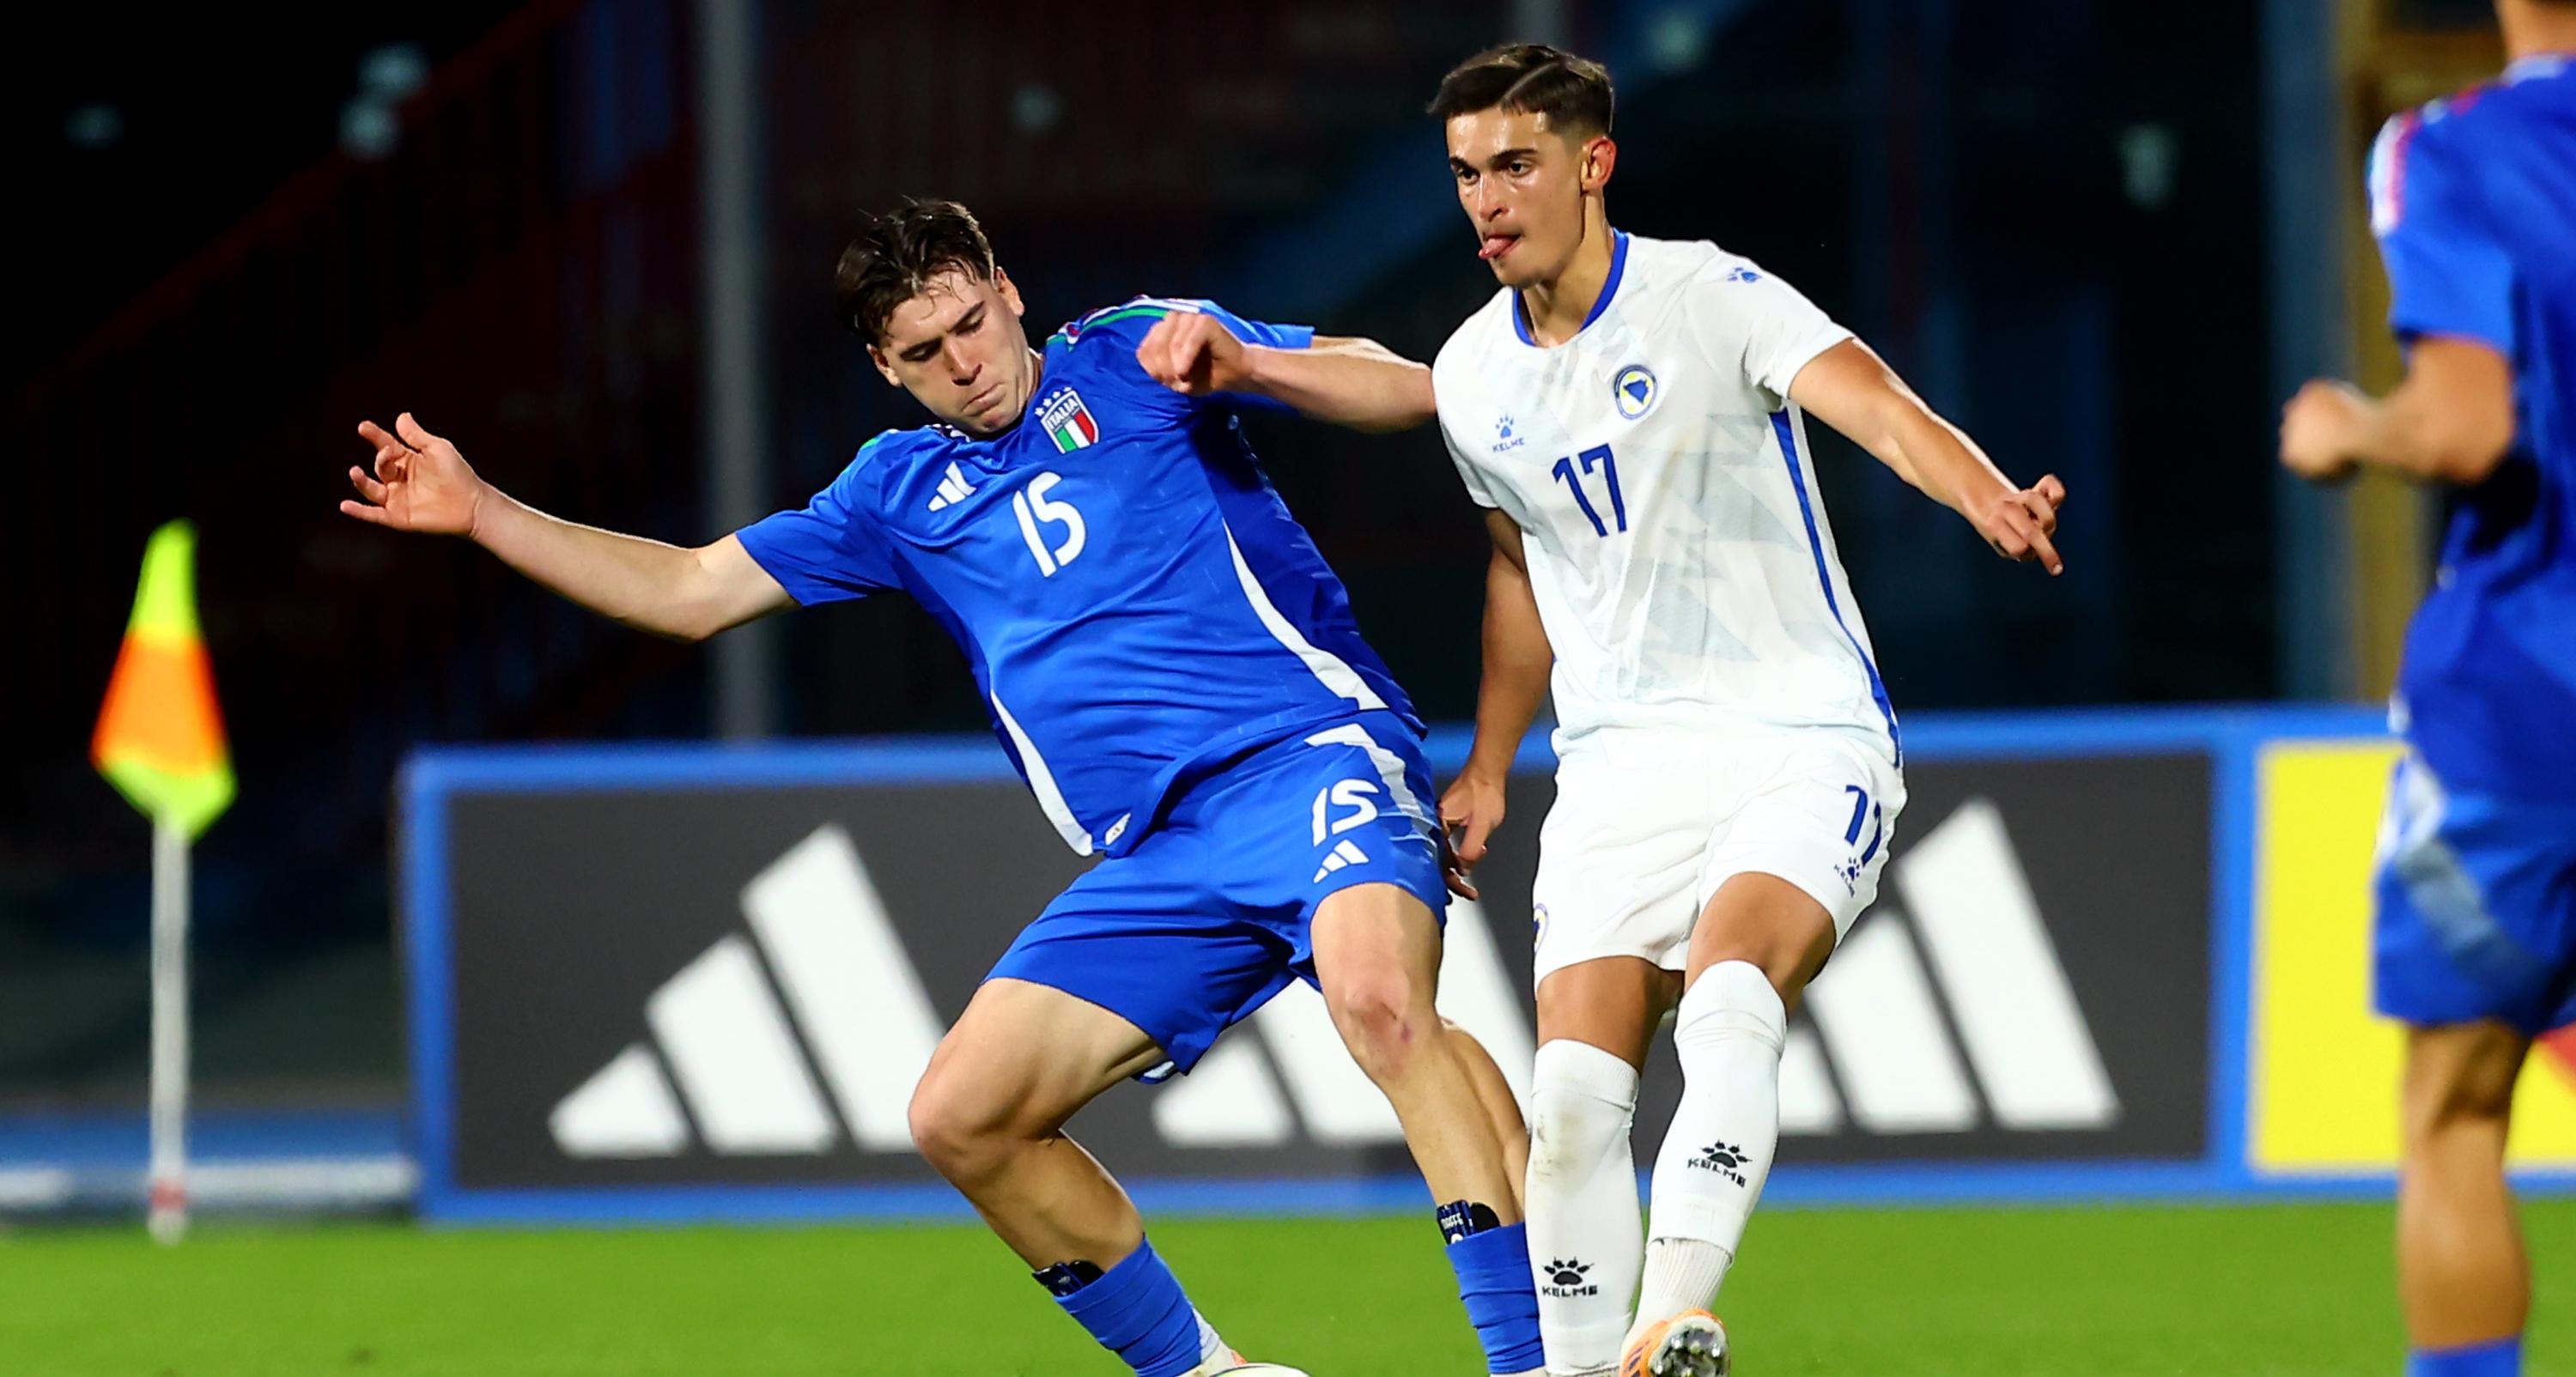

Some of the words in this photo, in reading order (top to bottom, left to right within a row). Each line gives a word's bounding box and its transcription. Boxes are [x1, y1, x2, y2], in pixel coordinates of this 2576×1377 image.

[1047, 397, 1078, 430] ITALIA
[1492, 436, 1525, 452] KELME
[1552, 443, 1627, 537] 17
[1012, 471, 1086, 578] 15
[1311, 778, 1380, 847] 15
[1687, 1157, 1747, 1188] KELME
[1542, 1284, 1598, 1298] KELME
